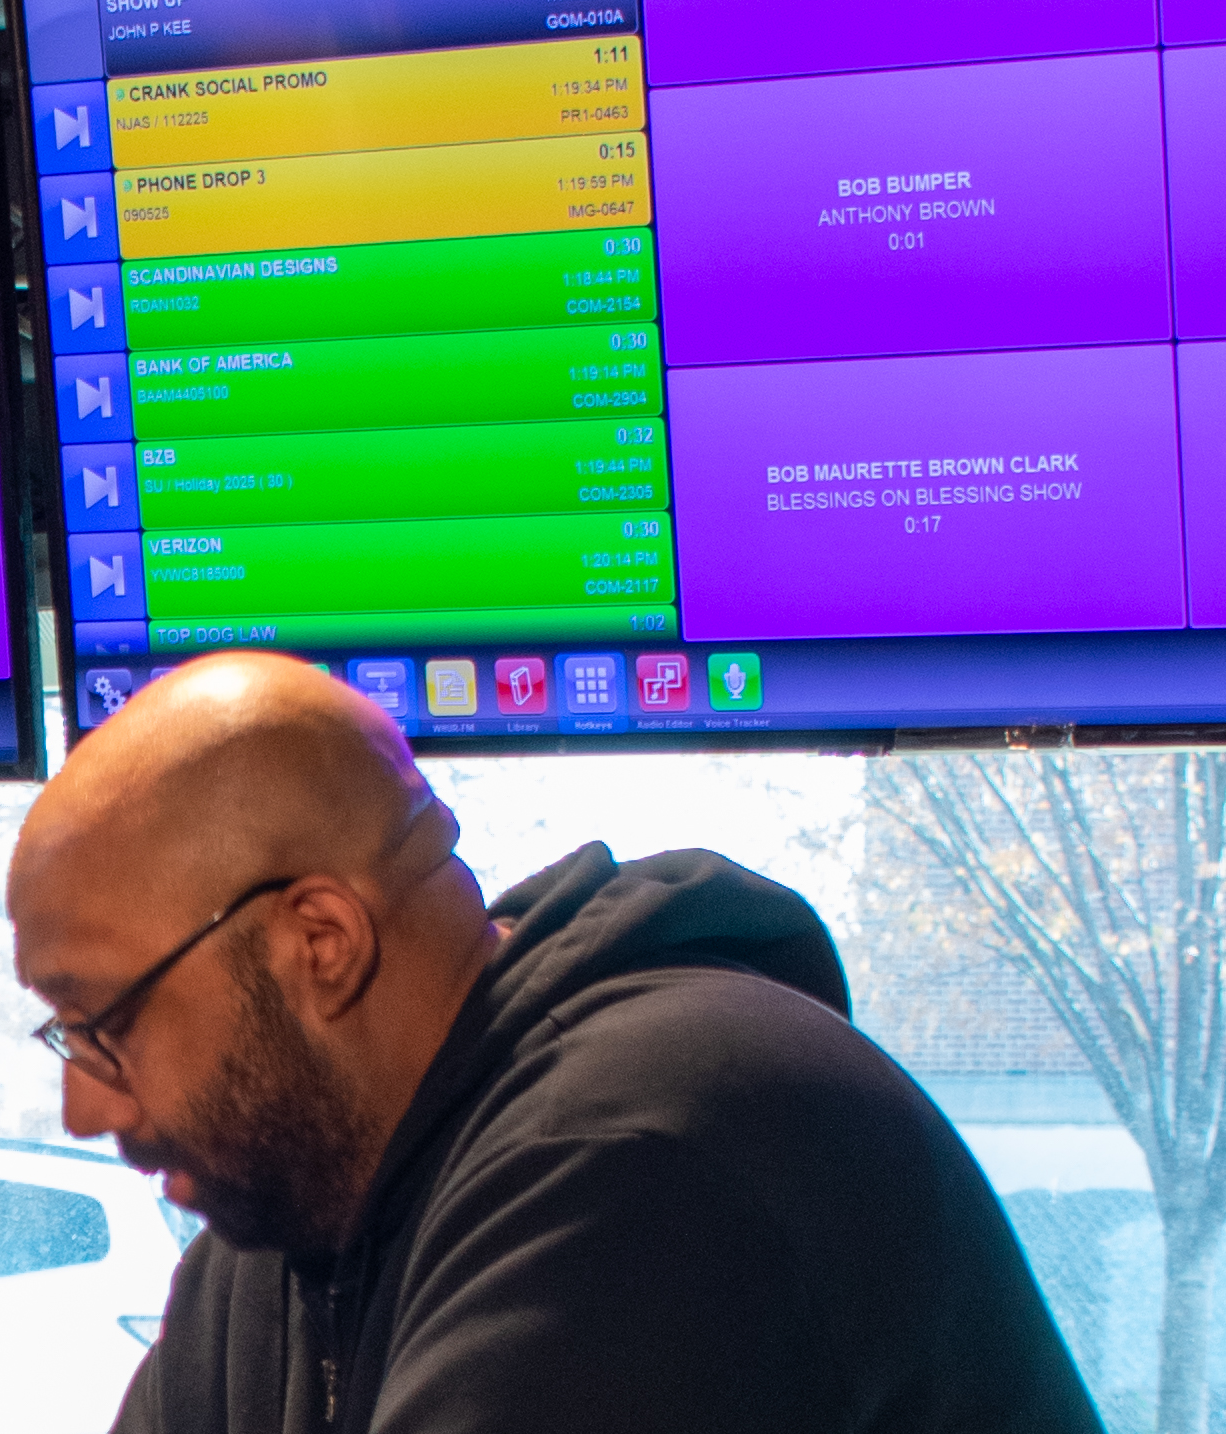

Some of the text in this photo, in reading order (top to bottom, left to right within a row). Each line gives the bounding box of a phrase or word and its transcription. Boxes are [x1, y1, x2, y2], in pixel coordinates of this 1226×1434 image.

[546, 9, 624, 29] GOM-010A
[109, 20, 192, 40] JOHN P KEE
[594, 46, 628, 64] 1:11
[129, 71, 327, 102] CRANK SOCIAL PROMO
[551, 78, 628, 96] 1:19:34 PM
[116, 112, 209, 131] NJAS 112225
[561, 106, 629, 123] PR1-0463
[599, 142, 635, 160] 0:15
[137, 170, 266, 194] PHONE DROP 3
[558, 174, 634, 191] 1:19:59 PM
[838, 171, 971, 197] BOB BUMPER
[124, 207, 169, 222] 090525
[568, 201, 635, 219] IMG-0647
[818, 198, 995, 227] ANTHONY BROWN
[605, 238, 641, 256] 0:30
[889, 231, 924, 251] 0:01
[129, 256, 338, 286] SCANDINAVIAN DESIGNS
[611, 332, 647, 350] 0:30
[136, 352, 293, 377] BANK OF AMERICA
[618, 427, 653, 445] 0:32
[143, 449, 176, 466] BZB
[767, 453, 1078, 484] BOB MAURETTE BROWN CLARK
[767, 482, 1082, 511] BLESSINGS ON BLESSING SHOW
[624, 521, 659, 539] 0:30
[904, 515, 942, 534] 0:17
[149, 538, 222, 556] VERIZON
[585, 579, 659, 595] COM-2117
[630, 615, 665, 631] 1:02
[157, 626, 276, 645] TOP DOG LAW
